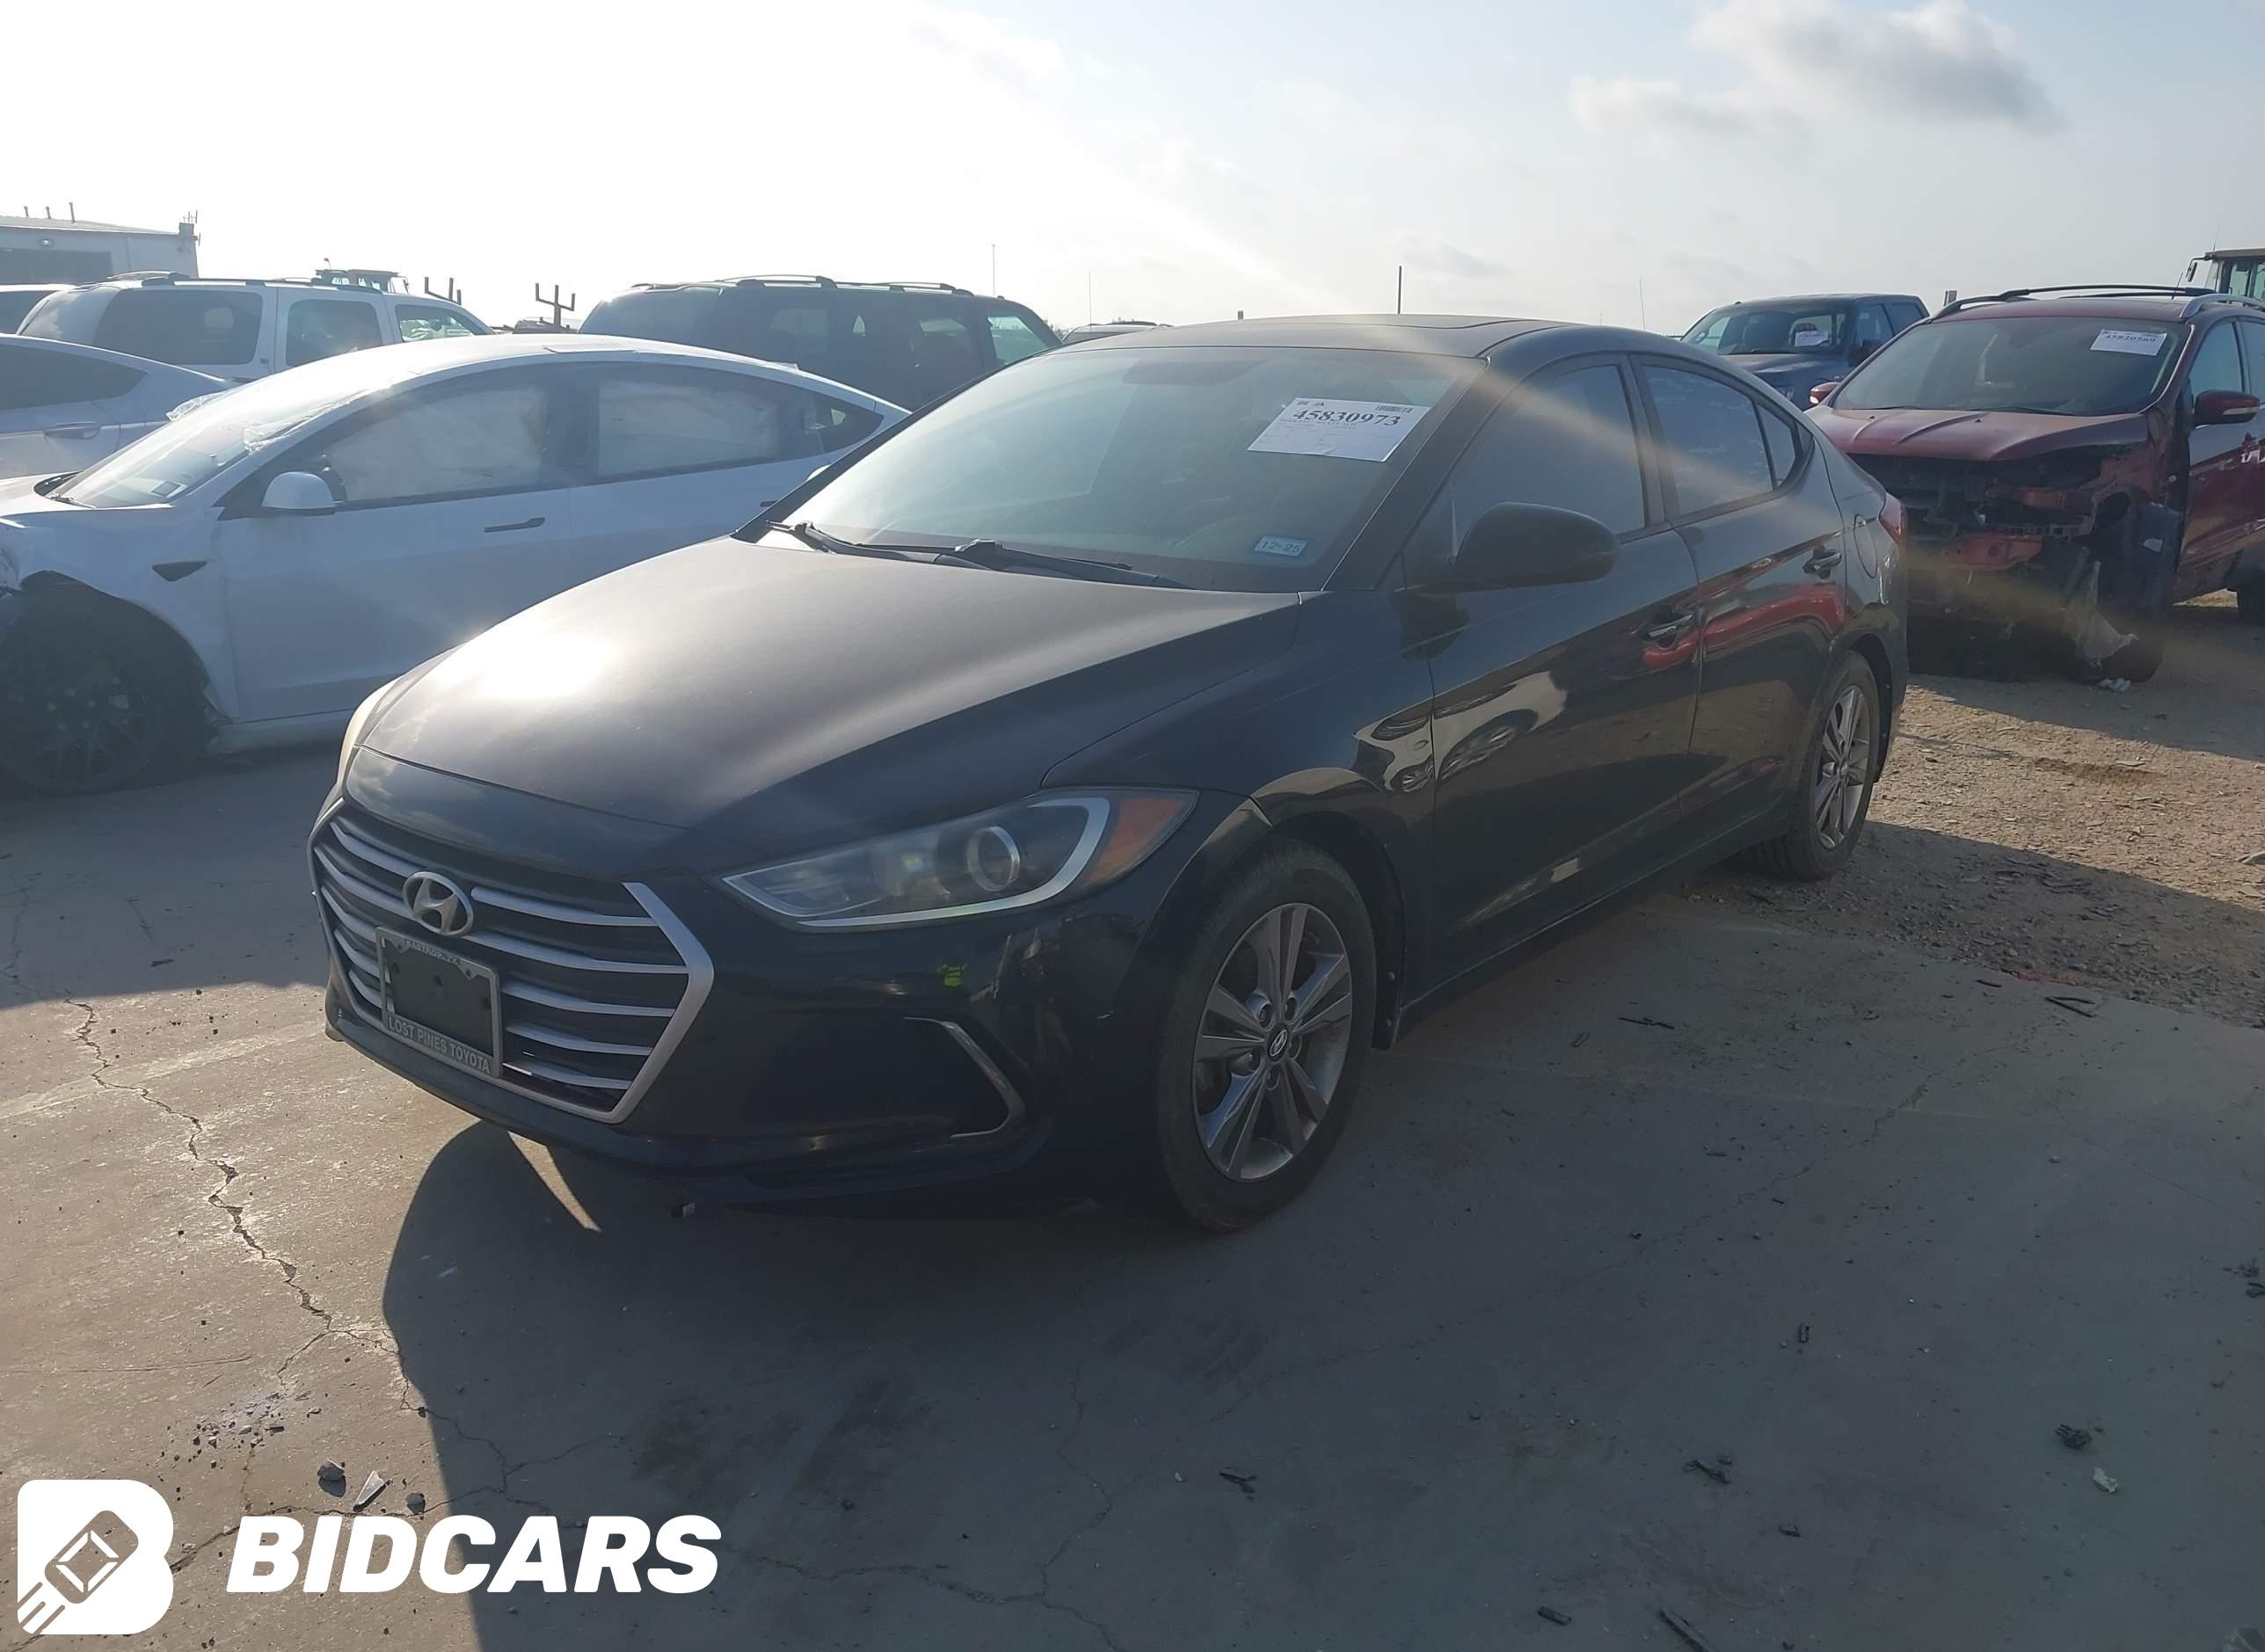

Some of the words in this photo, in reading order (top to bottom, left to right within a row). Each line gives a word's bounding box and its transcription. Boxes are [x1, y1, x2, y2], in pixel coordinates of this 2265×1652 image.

[1293, 410, 1402, 426] 45830973
[389, 1016, 414, 1037] LOST
[418, 1032, 447, 1054] PINES
[450, 1044, 491, 1074] TOYOTA
